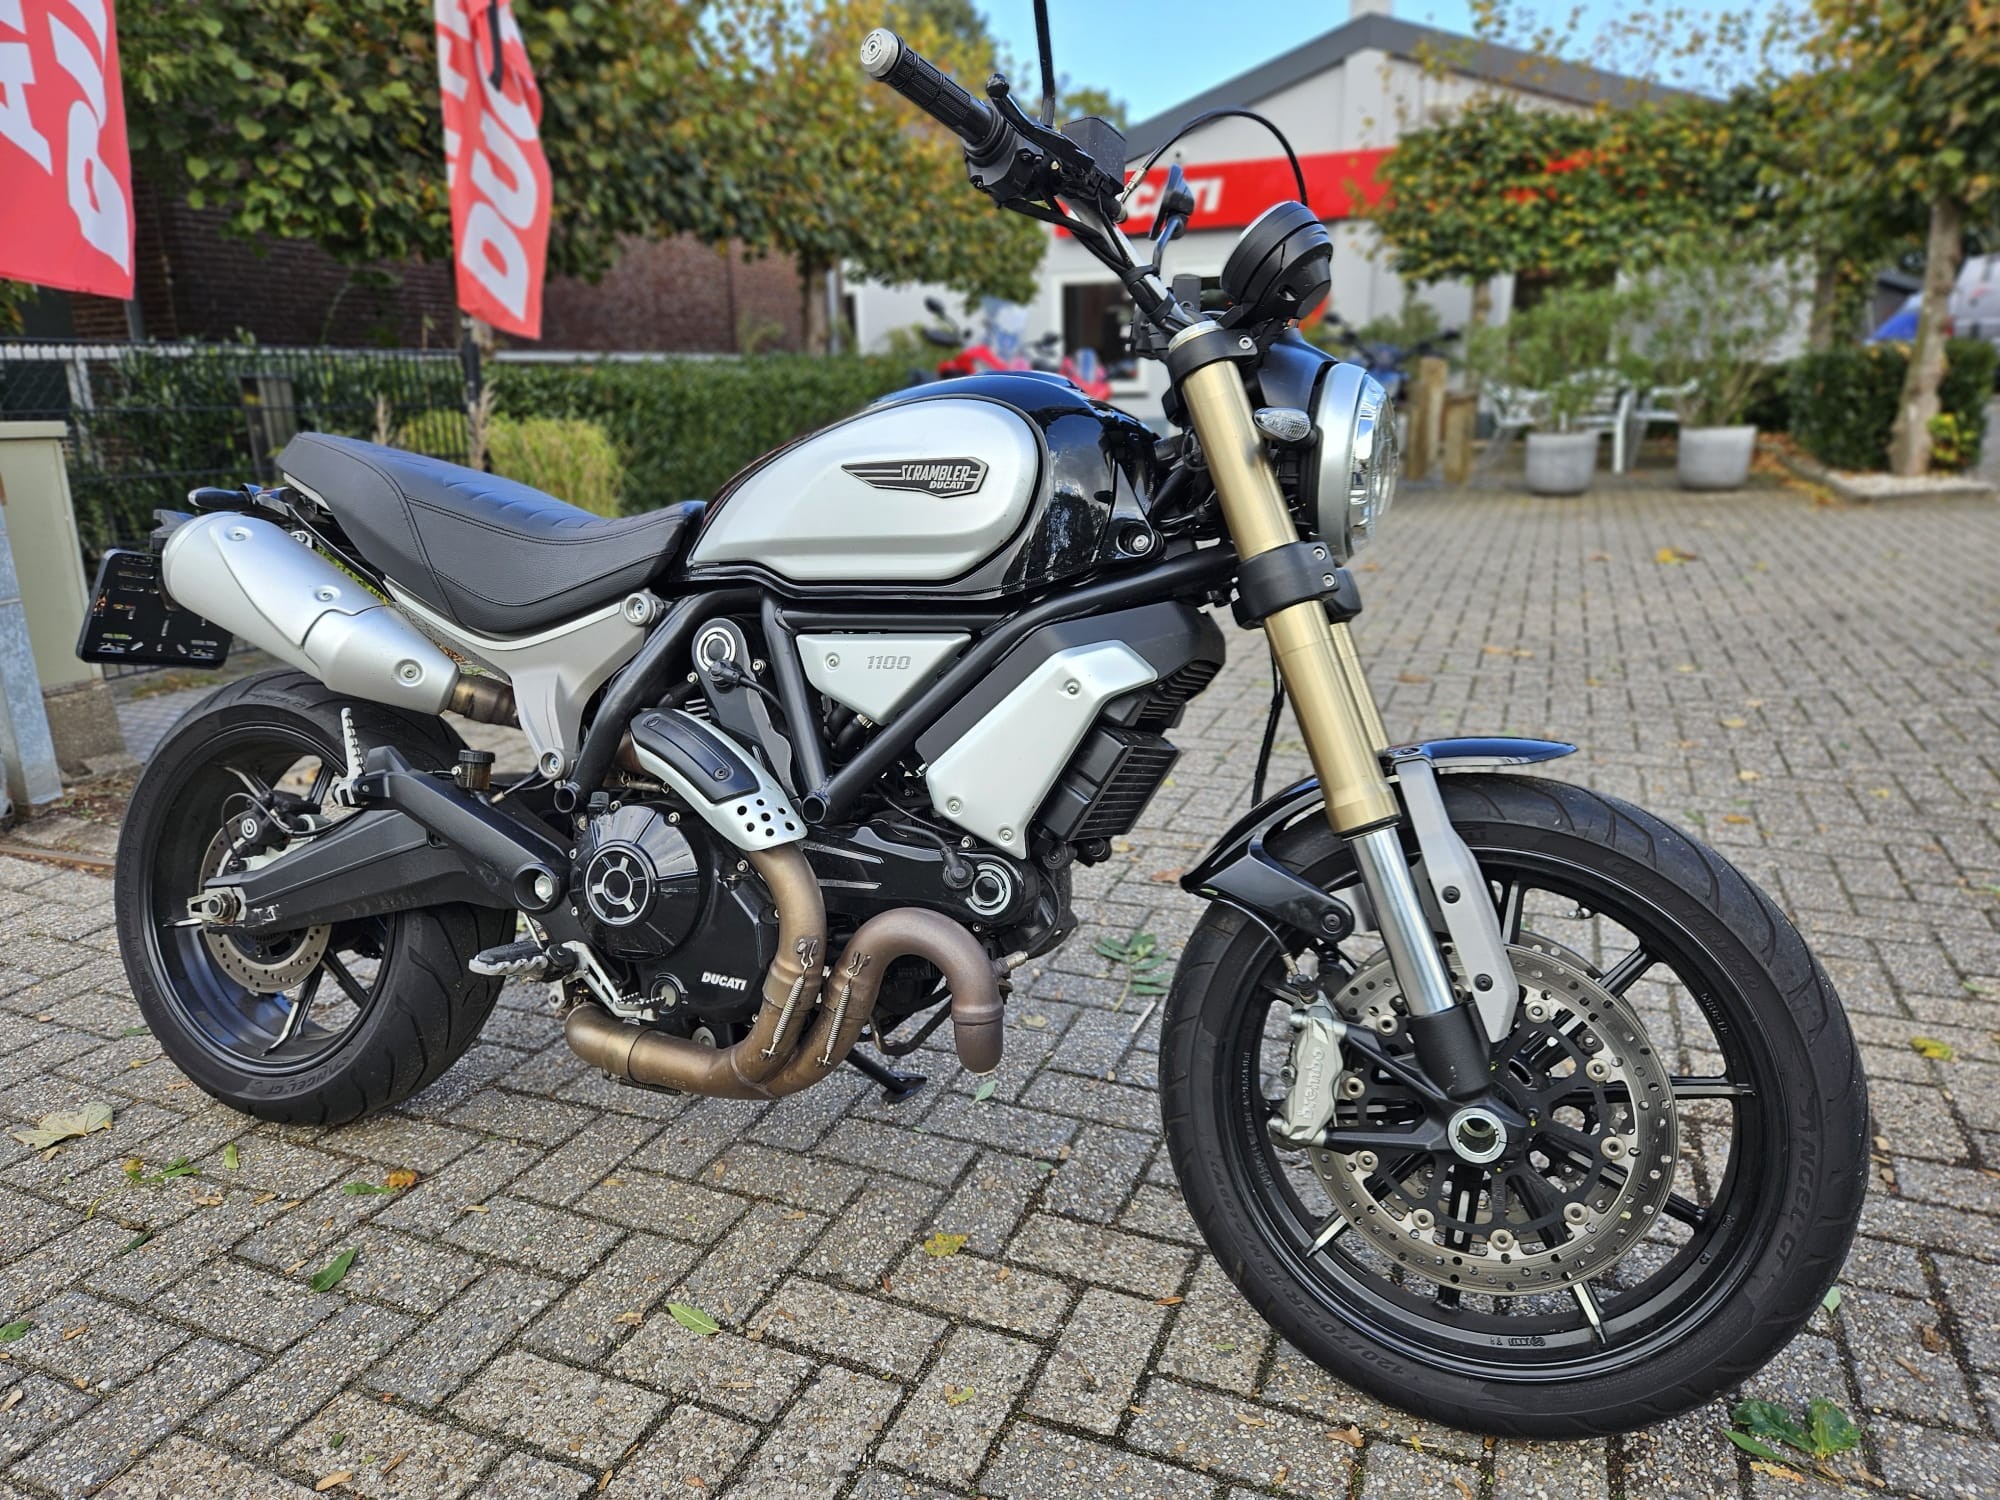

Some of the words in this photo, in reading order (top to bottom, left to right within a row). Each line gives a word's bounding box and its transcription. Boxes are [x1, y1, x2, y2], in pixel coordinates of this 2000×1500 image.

[460, 0, 540, 322] DUC
[900, 464, 971, 481] SCRAMBLER
[929, 480, 966, 490] DUCATI
[866, 655, 911, 670] 1100
[701, 971, 748, 991] DUCATI
[1297, 1047, 1325, 1120] brembo
